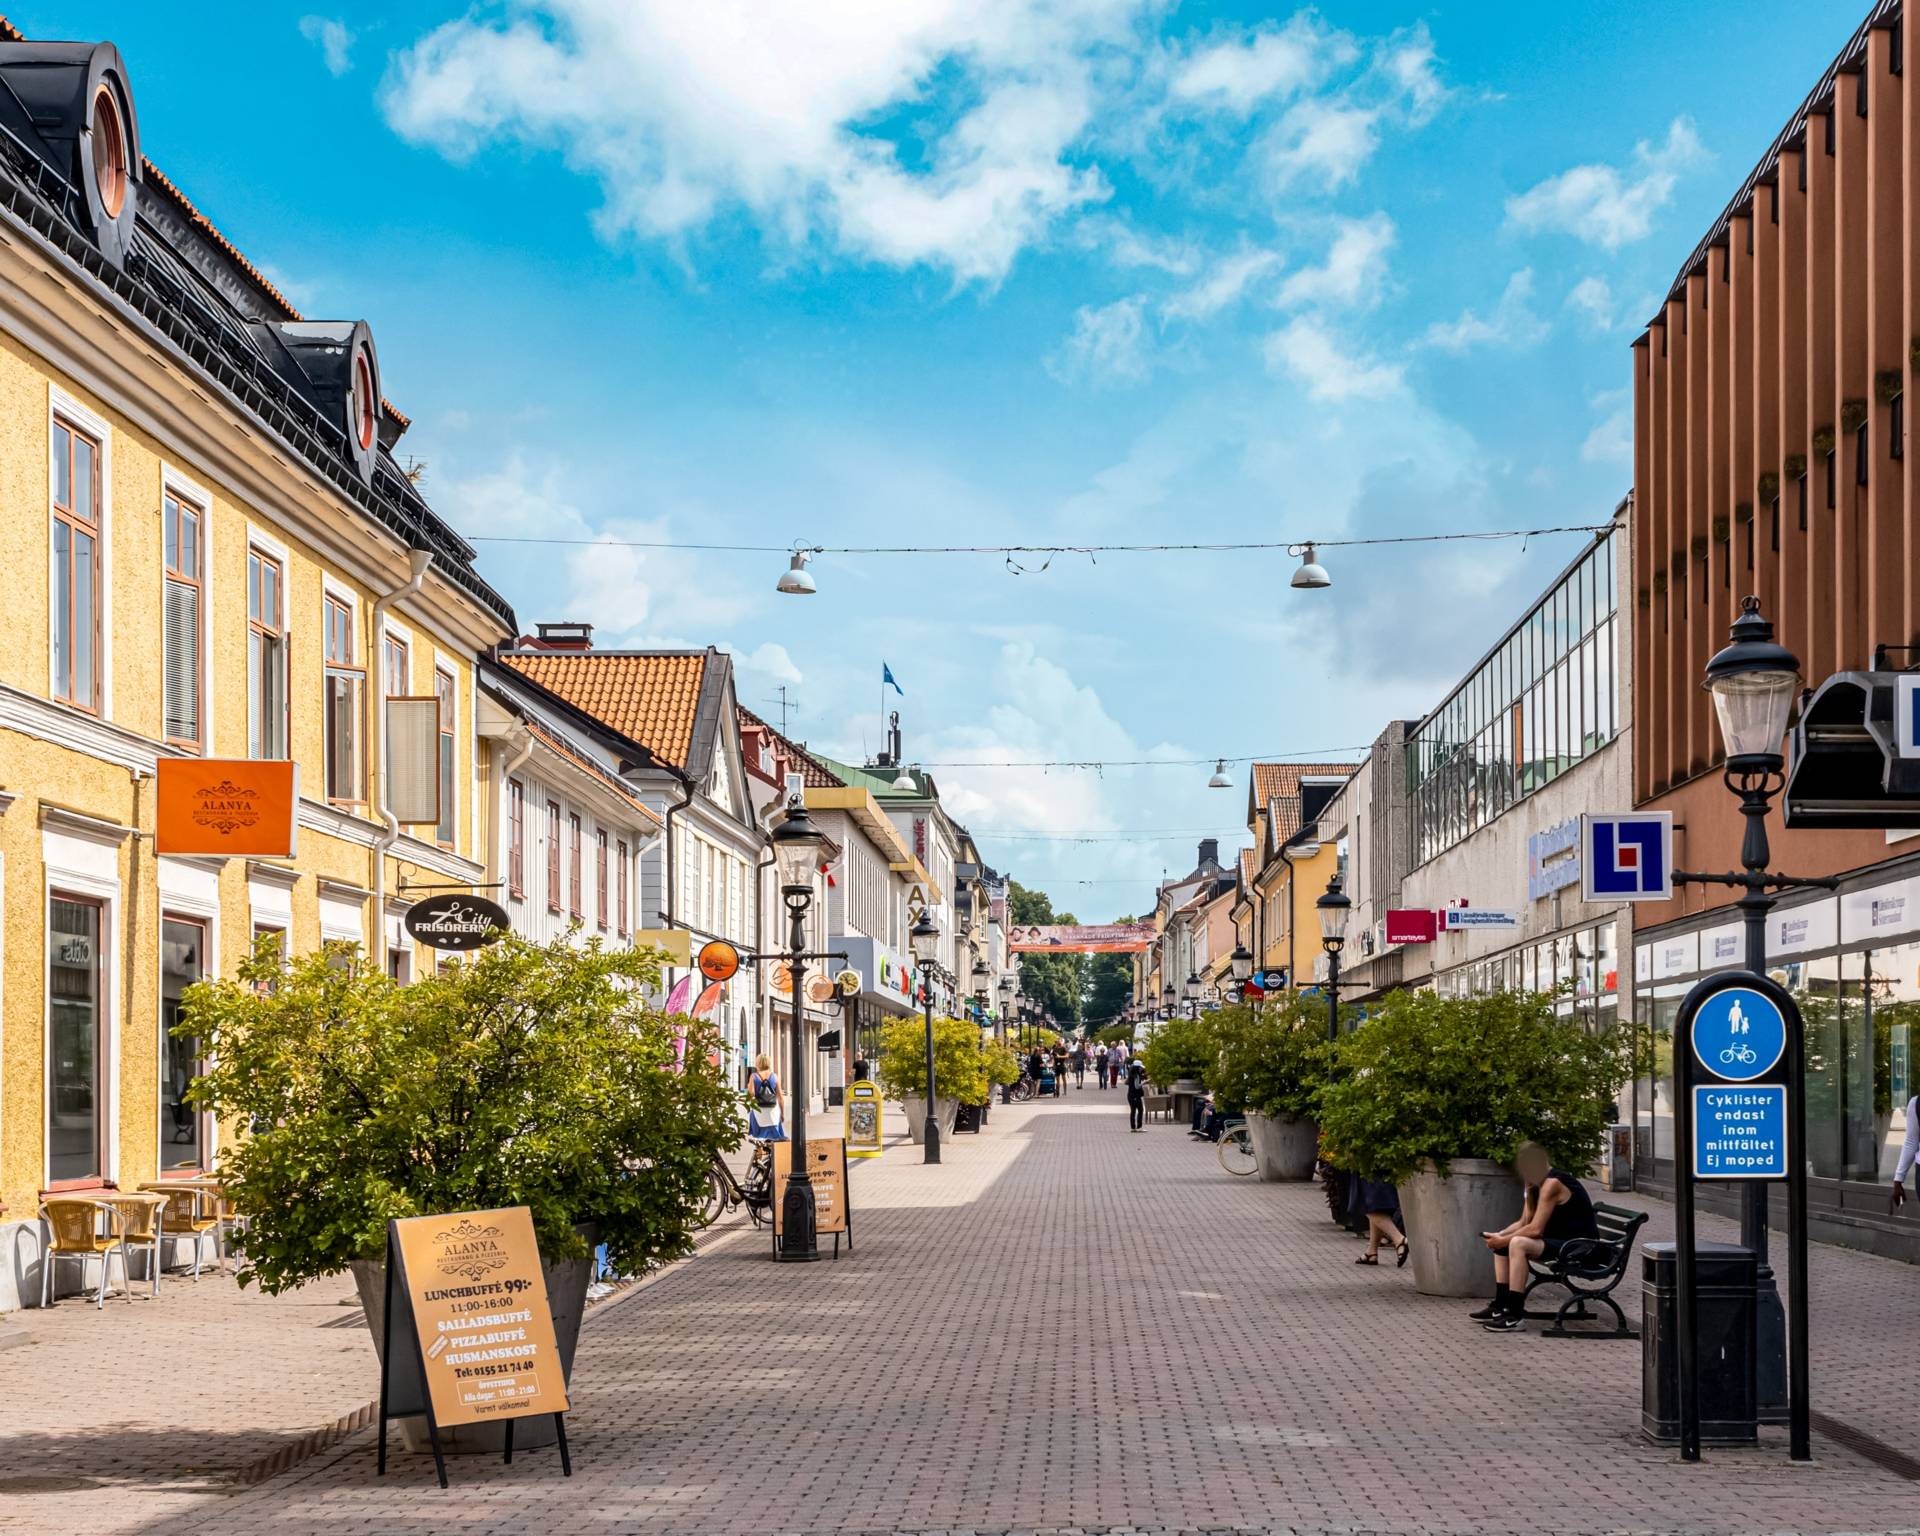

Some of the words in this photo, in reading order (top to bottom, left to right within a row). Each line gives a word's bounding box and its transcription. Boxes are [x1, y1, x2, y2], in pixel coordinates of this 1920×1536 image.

[201, 801, 251, 810] ALANYA
[415, 922, 487, 933] FRISÖRERN
[455, 907, 492, 938] City
[1706, 1094, 1773, 1107] Cyklister
[1715, 1110, 1765, 1120] endast
[1723, 1124, 1757, 1135] inom
[1706, 1139, 1774, 1150] mittfältet
[1707, 1155, 1719, 1167] Ej
[1725, 1155, 1774, 1167] moped
[444, 1240, 498, 1256] ALANYA
[424, 1281, 503, 1301] LUNCHBUFFÉ
[504, 1279, 532, 1294] 99:-
[437, 1309, 533, 1332] SALLADSBUFFÉ
[450, 1327, 527, 1349] PIZZABUFFÉ
[445, 1344, 537, 1365] HUSMANSKOST
[454, 1368, 473, 1378] Tel:
[474, 1364, 496, 1376] 0155
[498, 1363, 509, 1373] 21
[510, 1362, 522, 1372] 74
[523, 1361, 534, 1370] 40
[474, 1403, 496, 1414] Varmt
